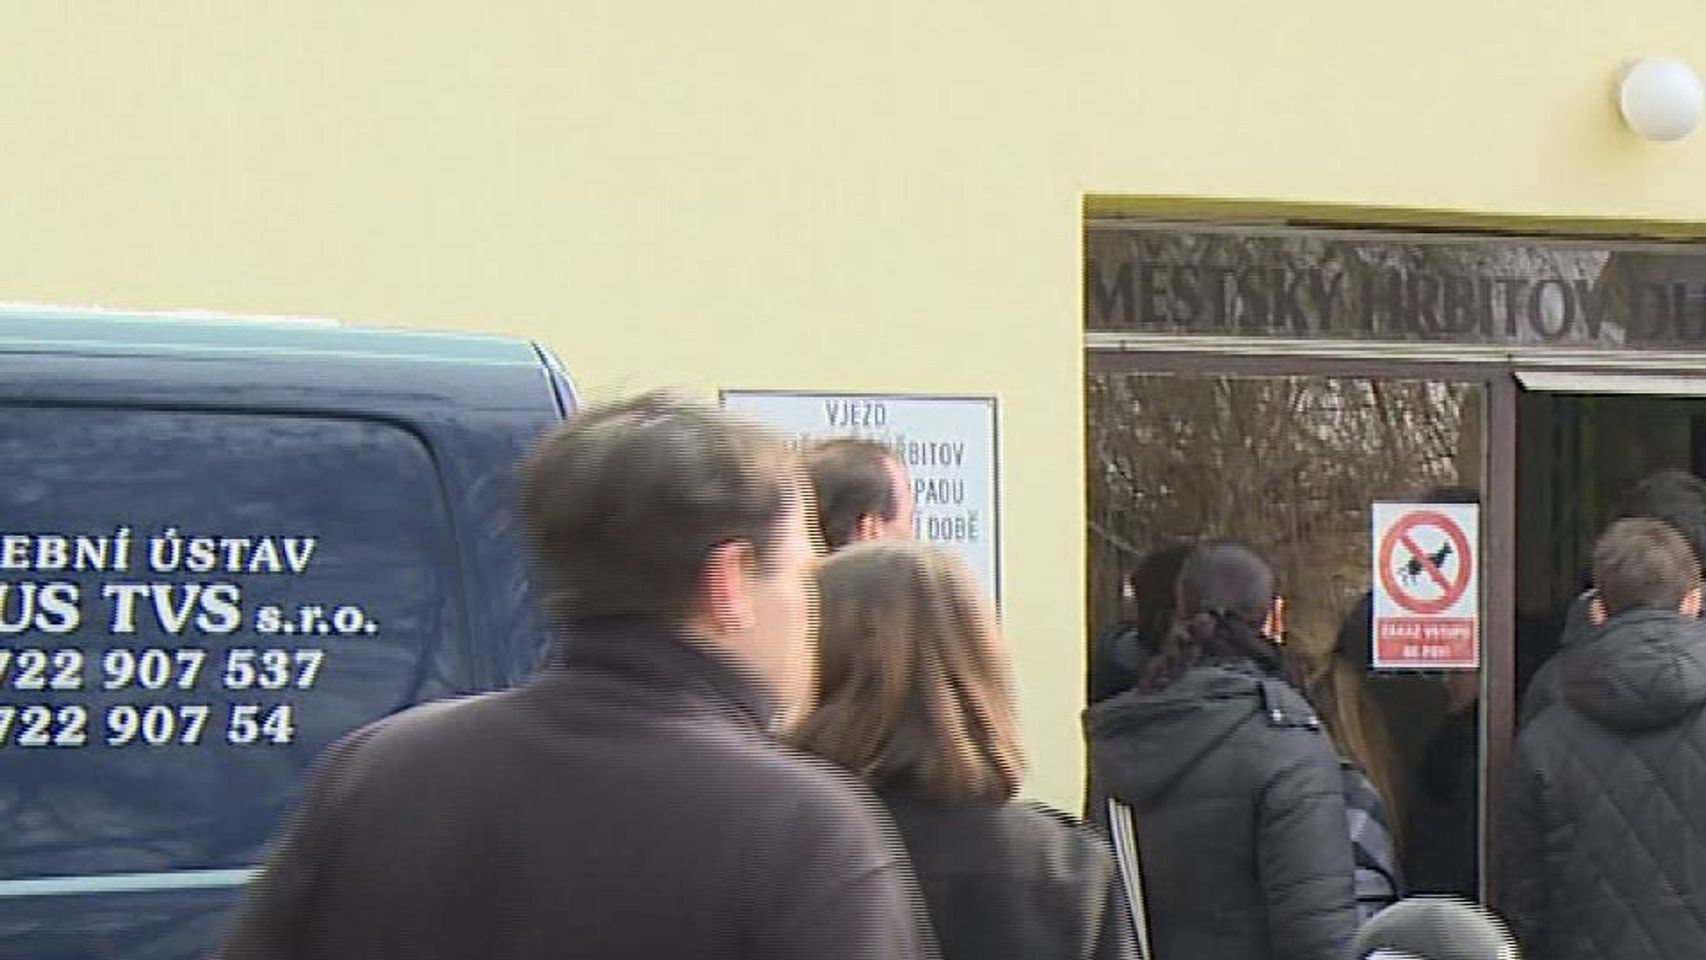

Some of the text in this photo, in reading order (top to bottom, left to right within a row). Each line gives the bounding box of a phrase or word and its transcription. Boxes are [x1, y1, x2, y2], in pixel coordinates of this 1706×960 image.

[825, 399, 886, 427] VJEZD
[914, 478, 965, 505] PADU
[2, 526, 317, 573] EBNÍ ÚSTAV
[0, 582, 378, 634] US TVS s.r.o.
[103, 648, 206, 690] 907
[223, 648, 325, 690] 537
[107, 705, 210, 745] 907
[227, 705, 296, 745] 54
